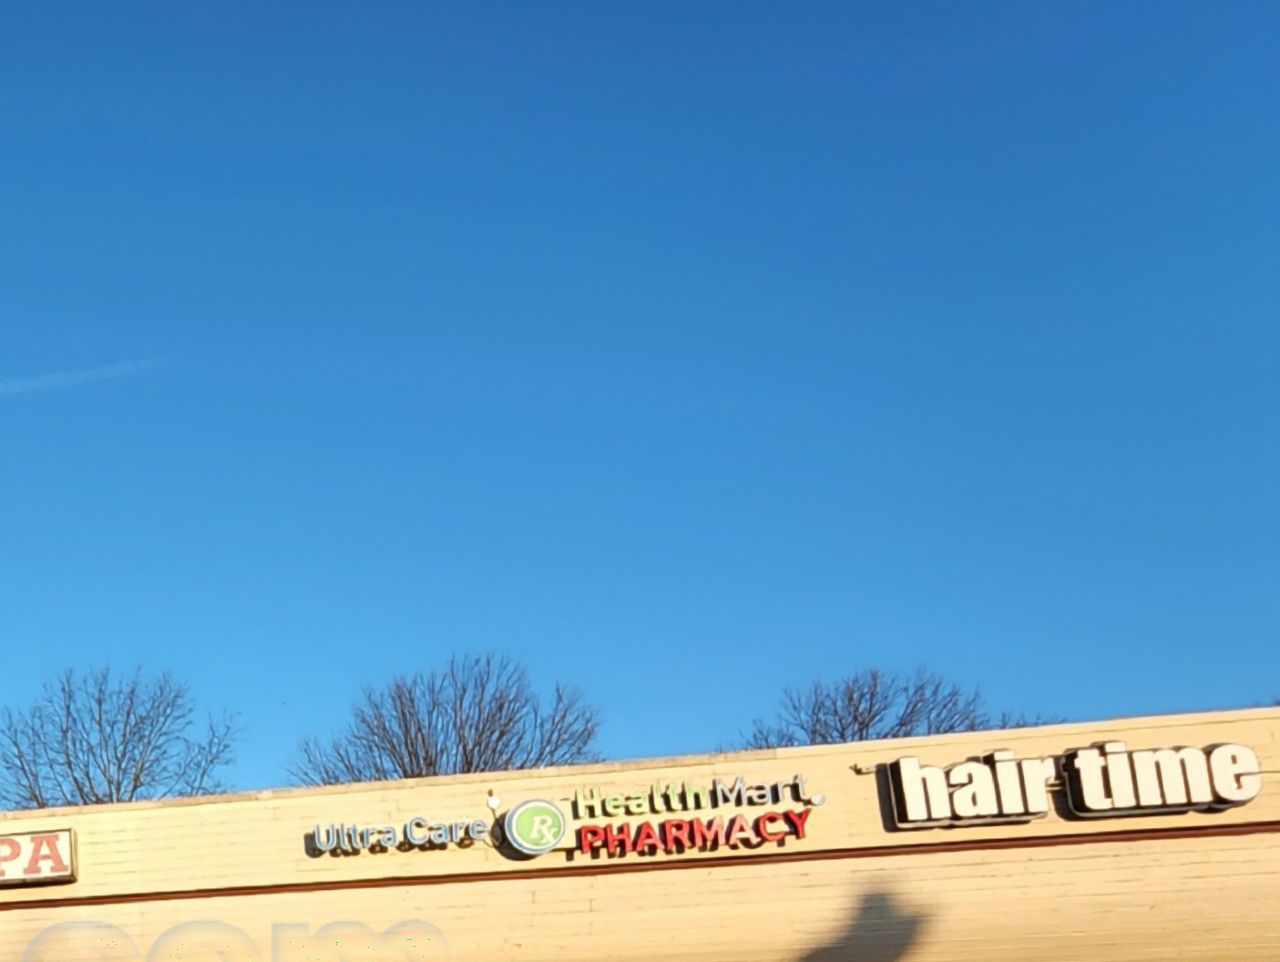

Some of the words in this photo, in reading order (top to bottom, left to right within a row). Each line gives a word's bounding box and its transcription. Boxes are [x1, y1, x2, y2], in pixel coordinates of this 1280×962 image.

[899, 750, 1056, 821] hair
[1075, 742, 1262, 811] time
[314, 823, 397, 851] Ultra
[405, 817, 489, 845] Care
[580, 808, 811, 854] PHARMACY
